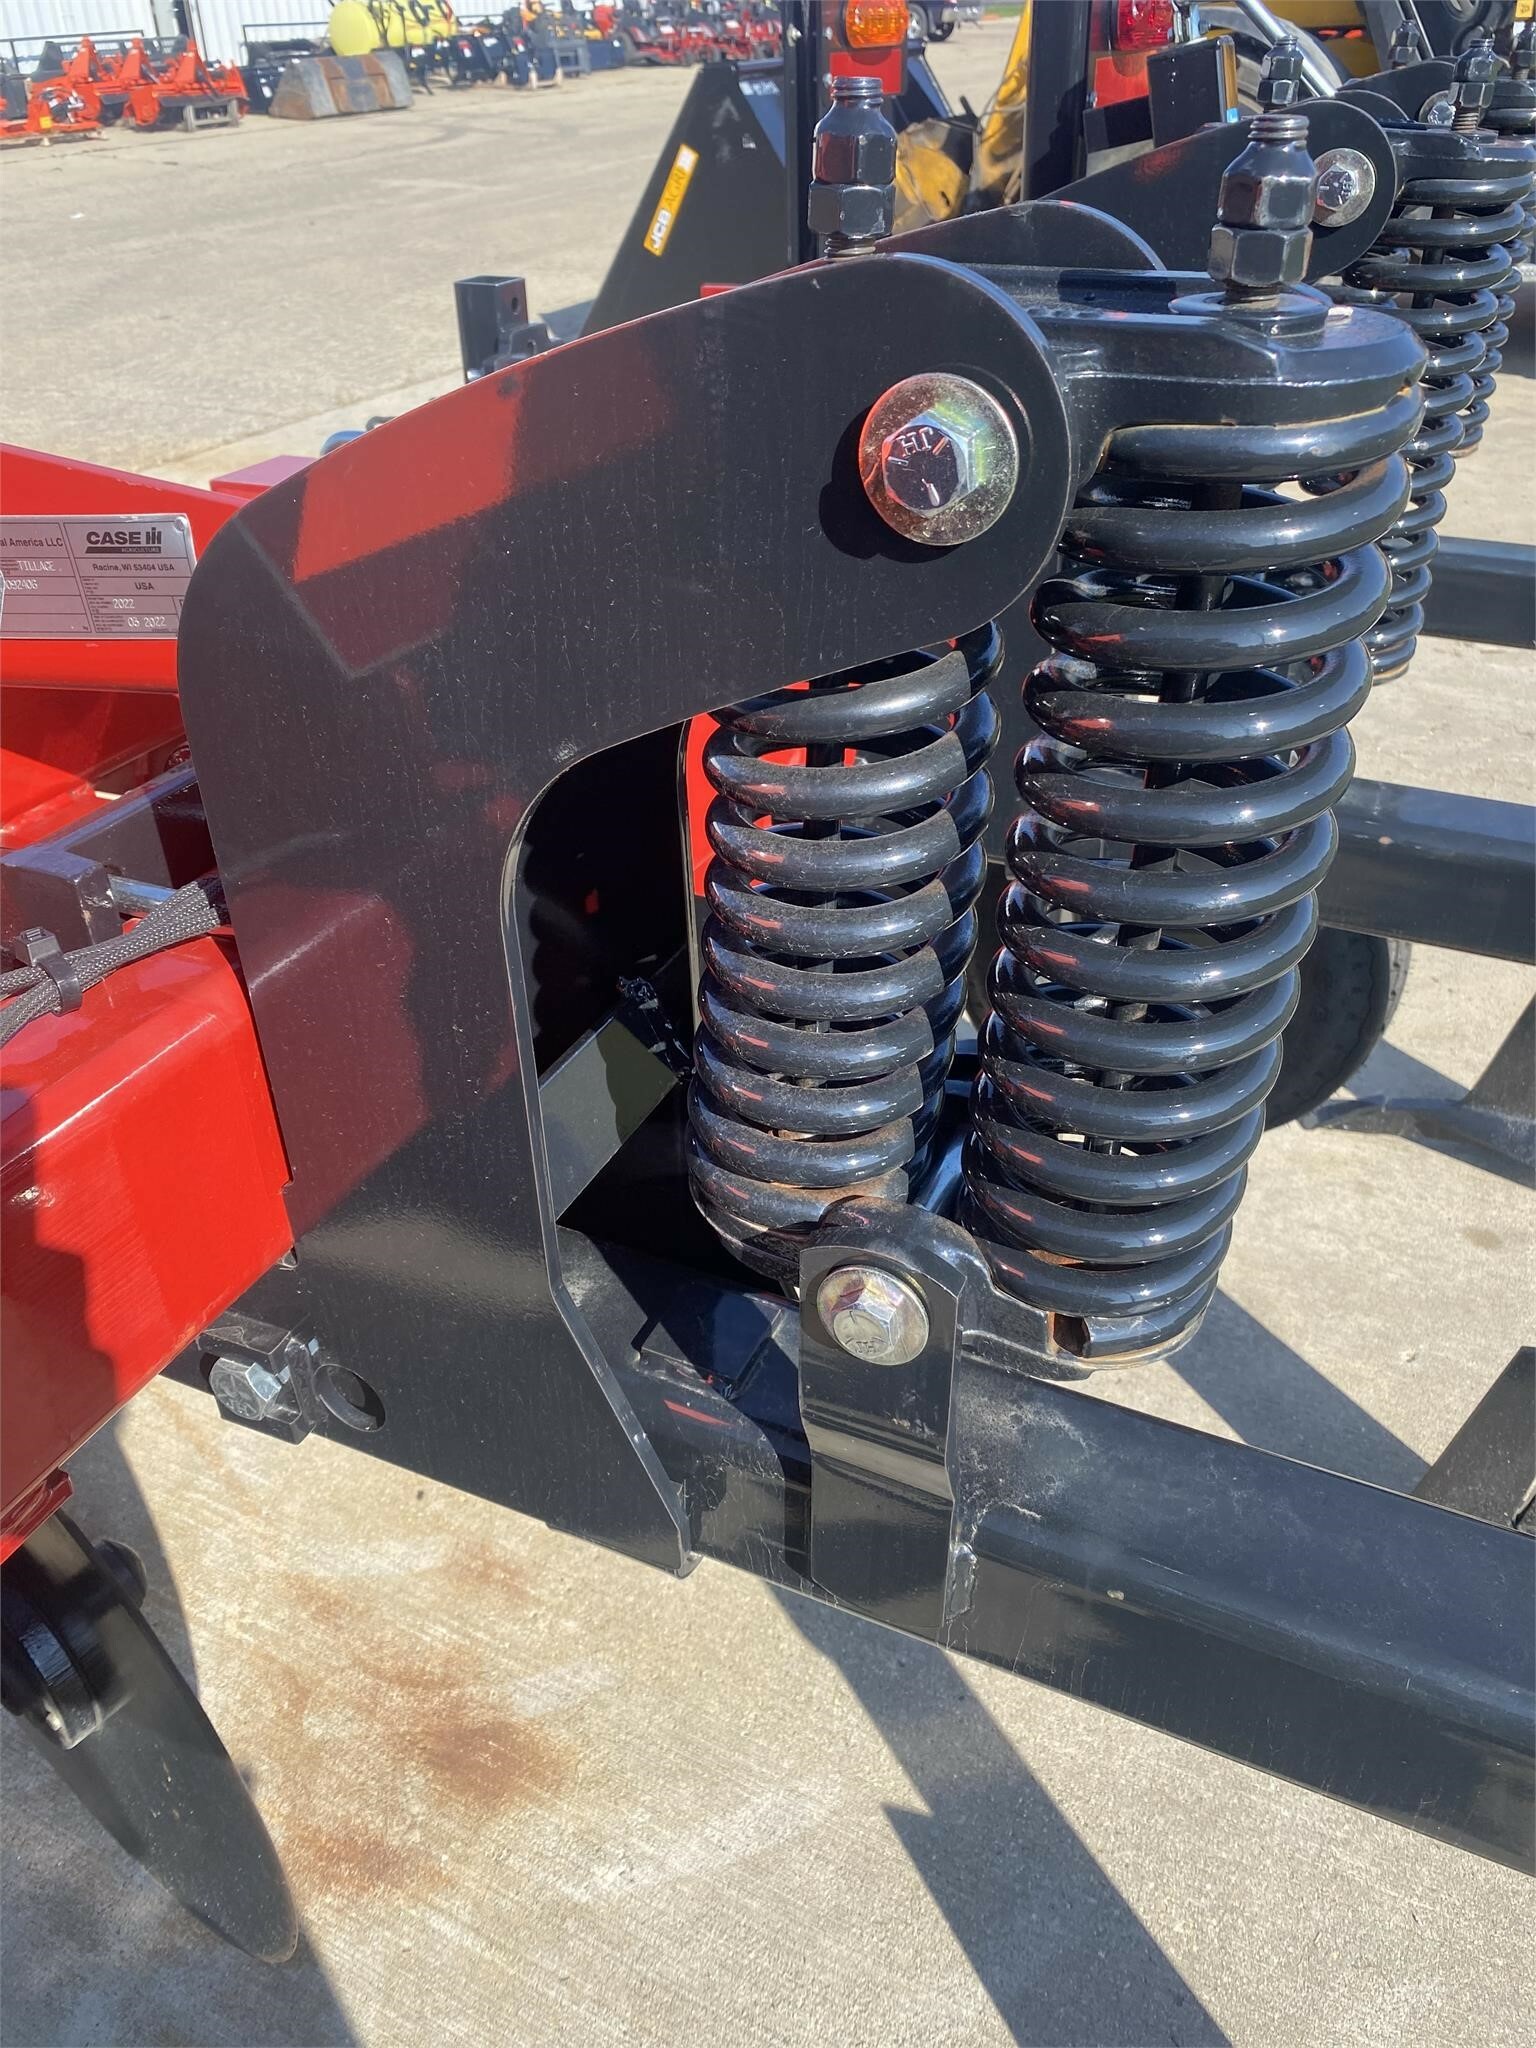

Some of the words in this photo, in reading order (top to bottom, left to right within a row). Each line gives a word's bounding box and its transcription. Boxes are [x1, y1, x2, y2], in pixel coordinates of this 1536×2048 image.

[651, 209, 671, 248] JCB
[9, 537, 44, 547] America
[45, 537, 64, 547] LLC
[86, 531, 142, 545] CASE
[157, 563, 175, 571] USA
[134, 581, 155, 591] USA
[112, 598, 135, 609] 2022
